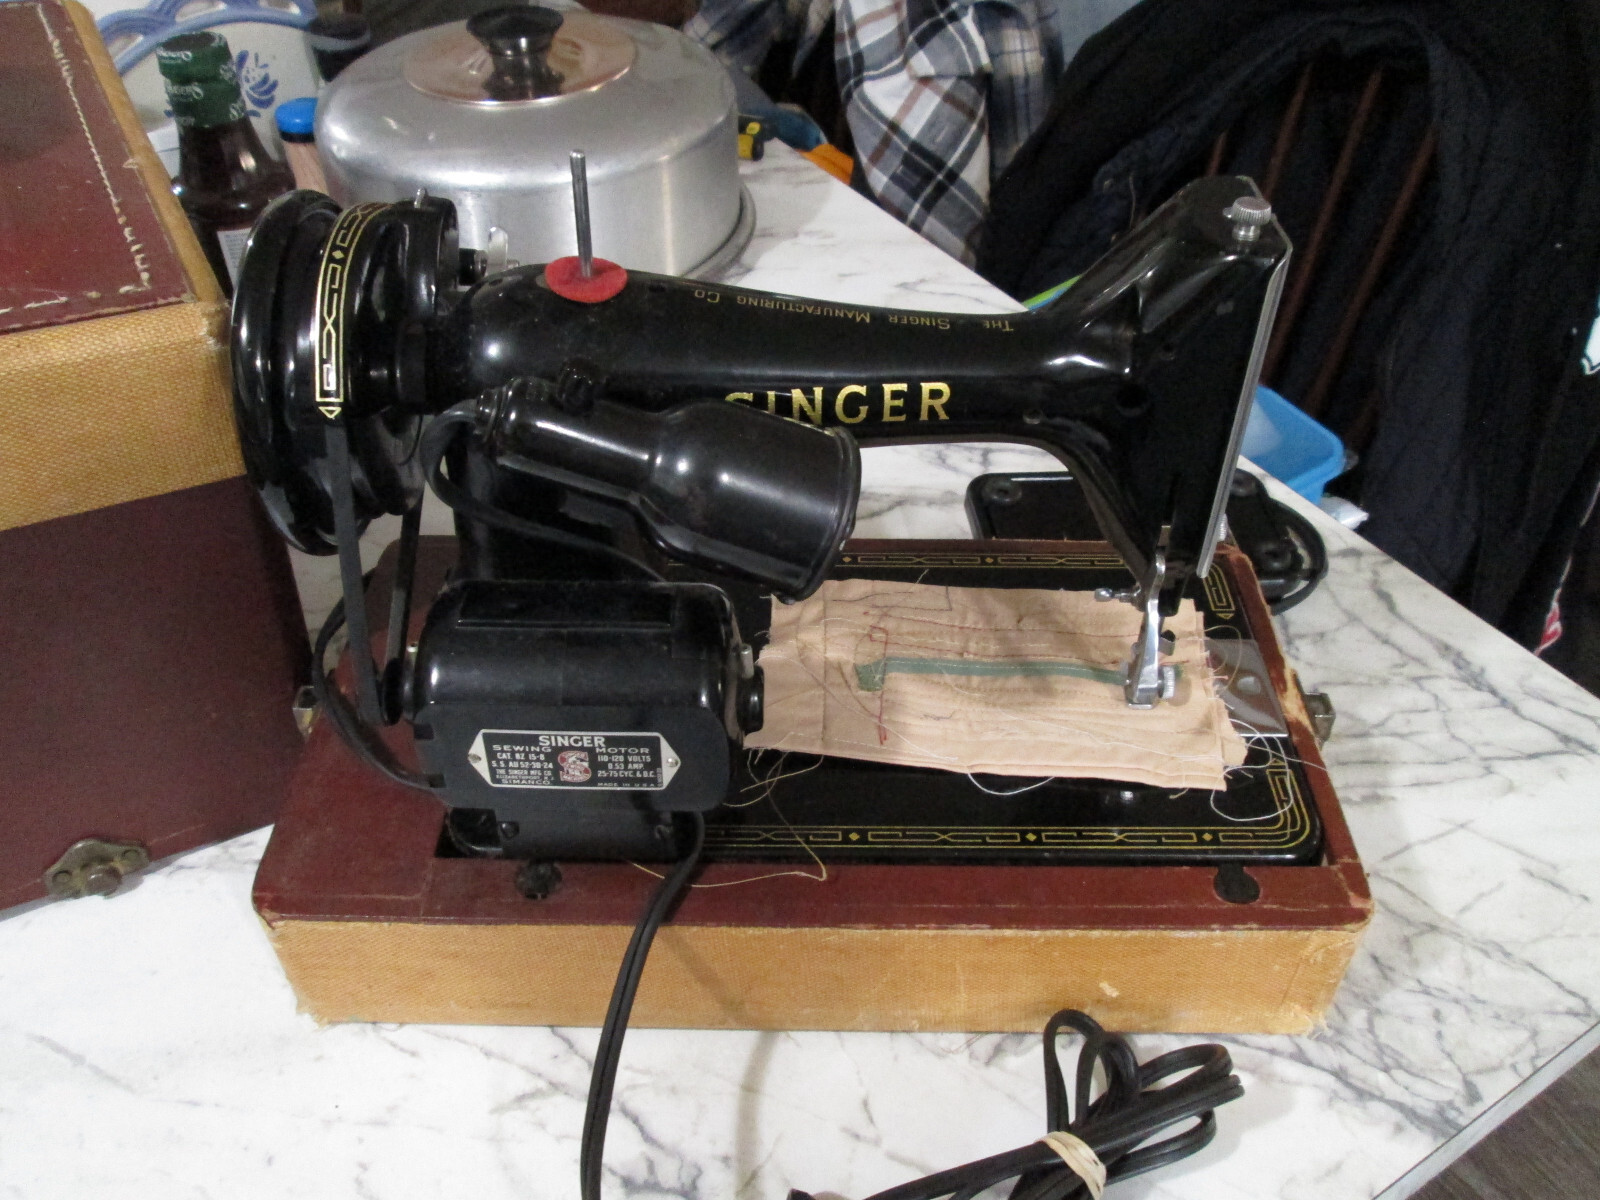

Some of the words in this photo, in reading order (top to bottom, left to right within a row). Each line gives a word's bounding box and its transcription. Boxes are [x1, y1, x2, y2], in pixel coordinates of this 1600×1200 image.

[736, 295, 870, 324] MANUFACTURING
[888, 314, 951, 330] SINGER
[982, 320, 1014, 332] THE
[539, 736, 606, 747] SINGER
[492, 744, 552, 752] SEWING
[627, 755, 652, 763] VOLTS
